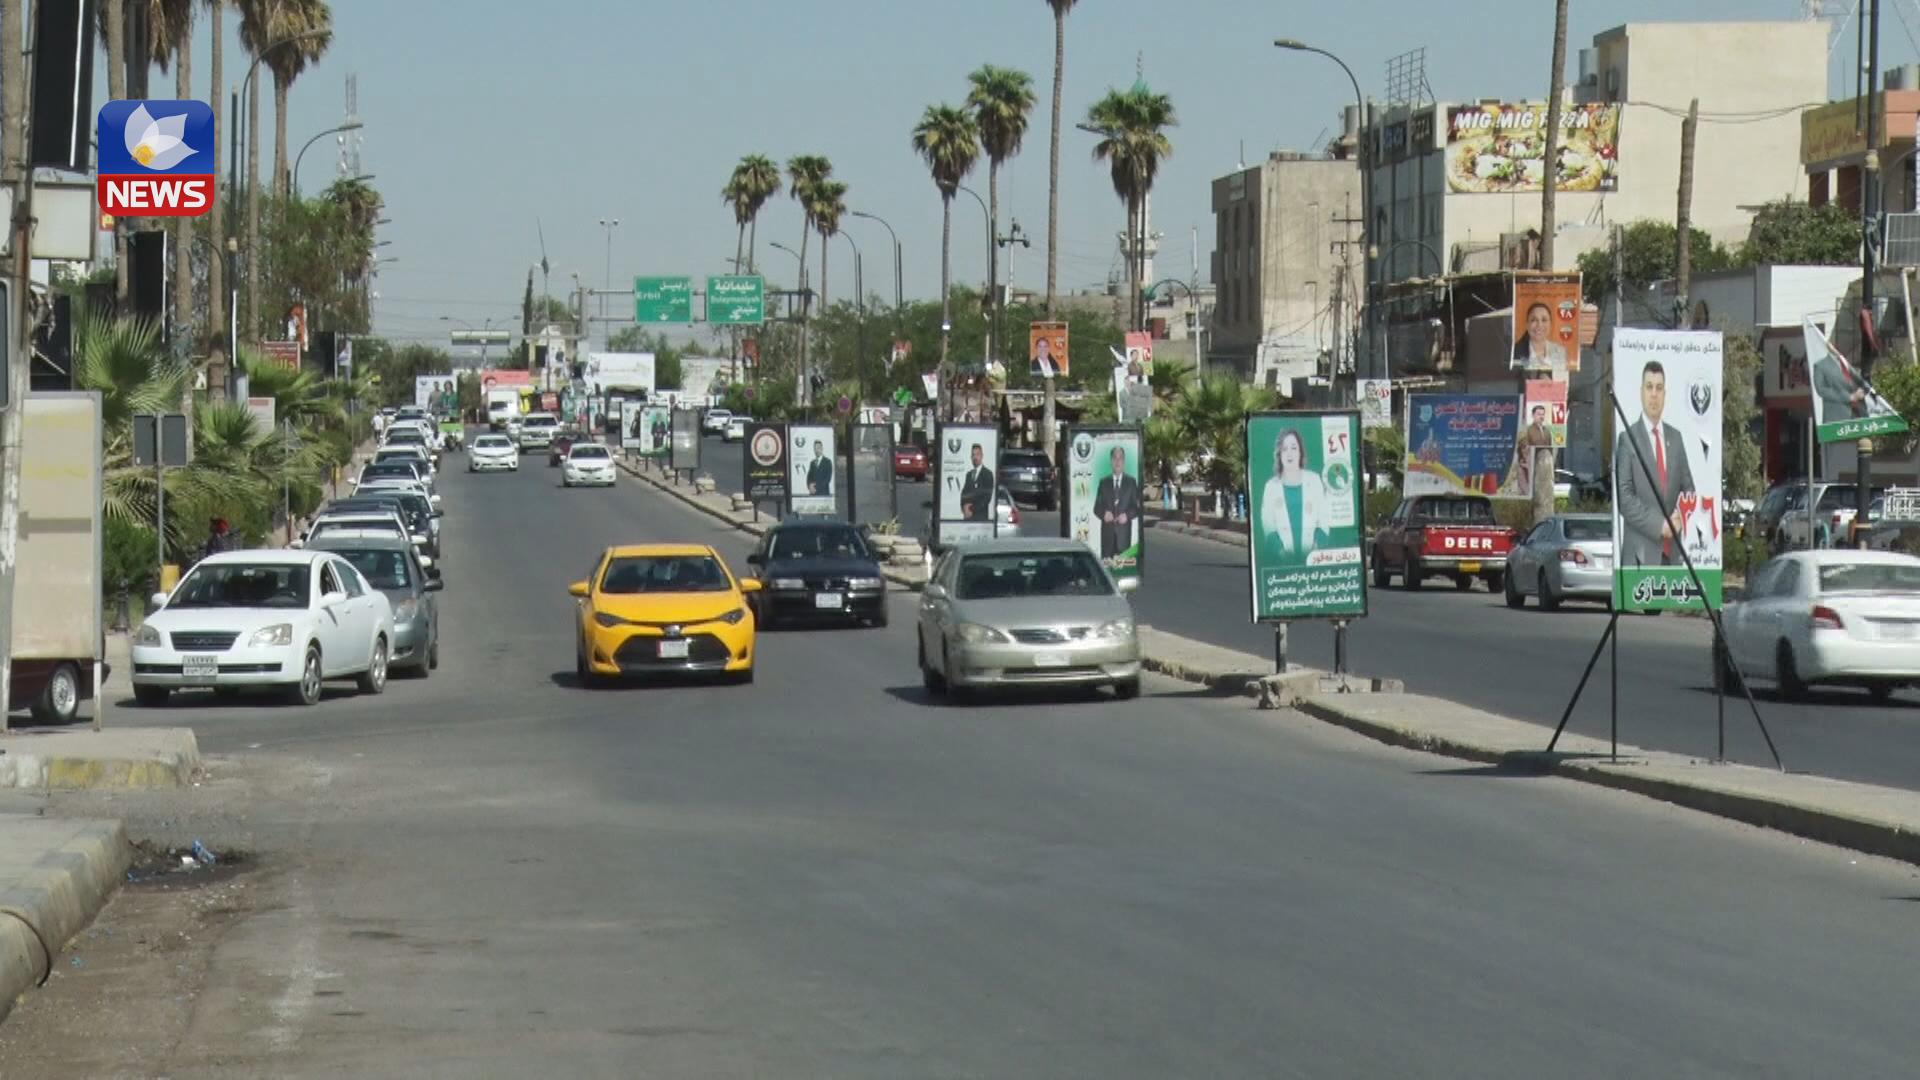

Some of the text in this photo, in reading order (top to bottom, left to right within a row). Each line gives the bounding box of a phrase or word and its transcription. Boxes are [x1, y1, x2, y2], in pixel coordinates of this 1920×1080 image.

[1455, 112, 1492, 129] MIG
[1496, 112, 1533, 129] MIG
[637, 291, 661, 300] Erbil
[1444, 536, 1493, 550] DEER
[1632, 575, 1668, 604] غازی
